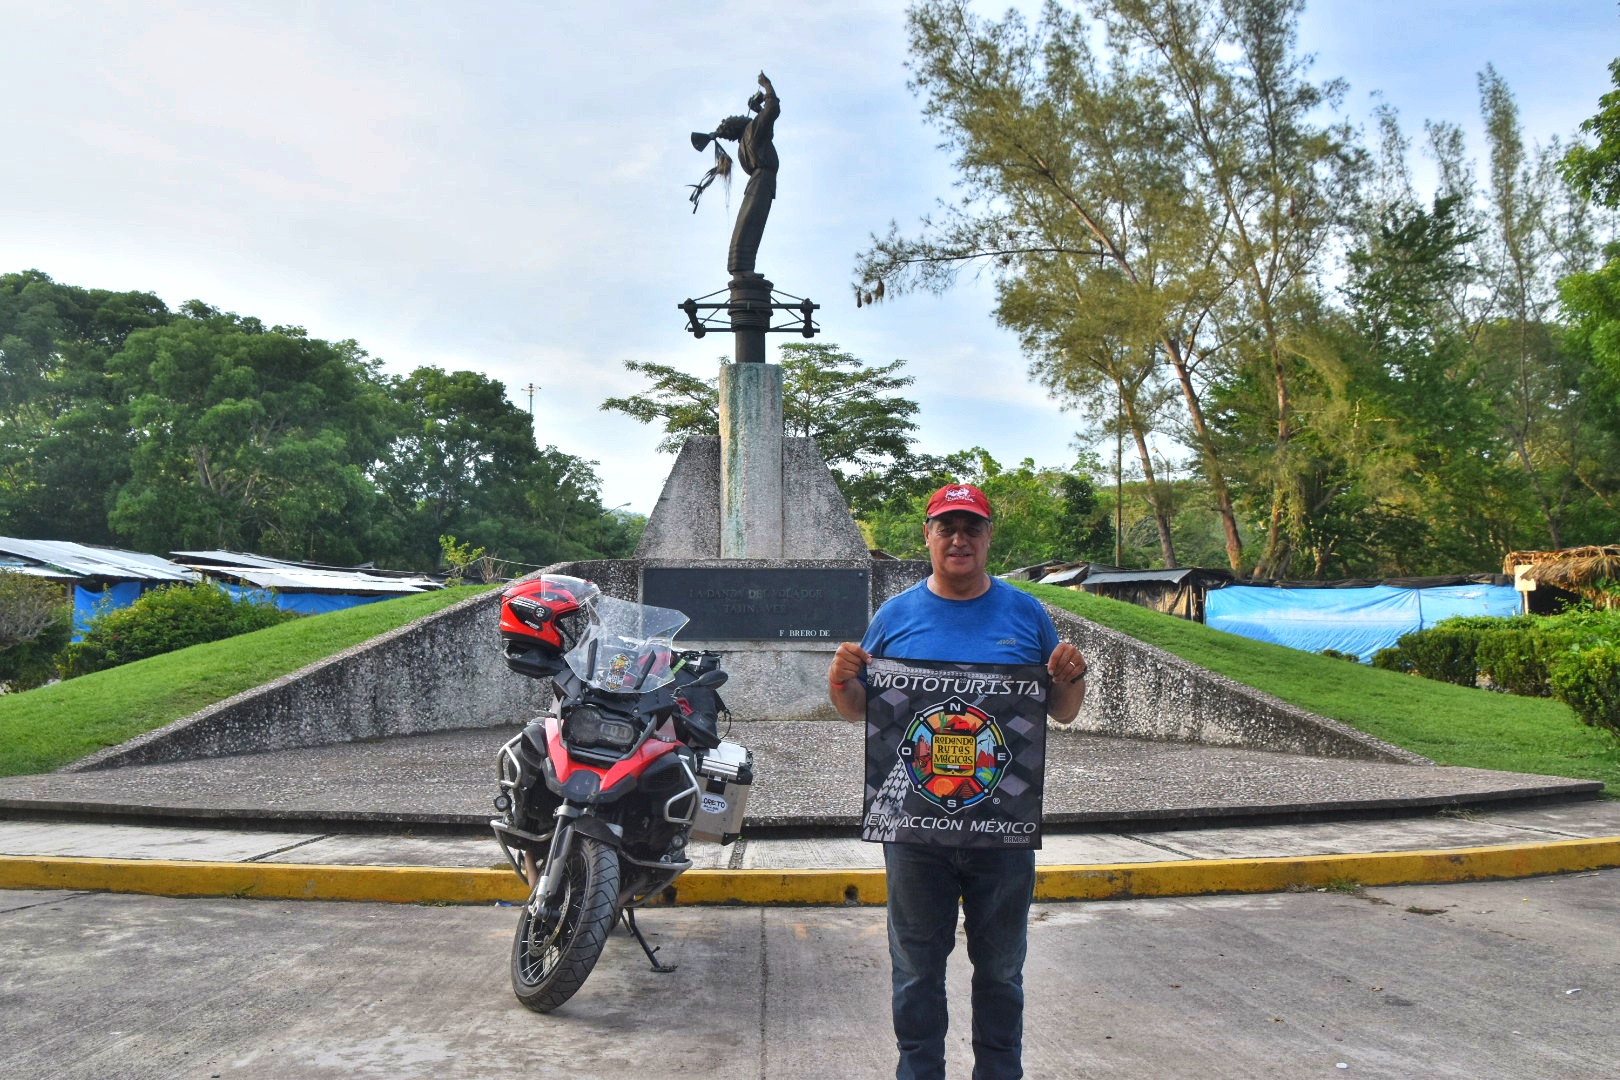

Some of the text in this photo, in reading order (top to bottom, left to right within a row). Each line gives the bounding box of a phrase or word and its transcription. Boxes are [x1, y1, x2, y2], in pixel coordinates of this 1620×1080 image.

[819, 629, 830, 637] DE
[872, 672, 1040, 695] MOTOTURISTA
[949, 703, 961, 711] N
[901, 747, 912, 756] O
[997, 752, 1006, 761] E
[947, 799, 957, 808] S
[867, 814, 1036, 834] EN ACCIÓN MÉXICO
